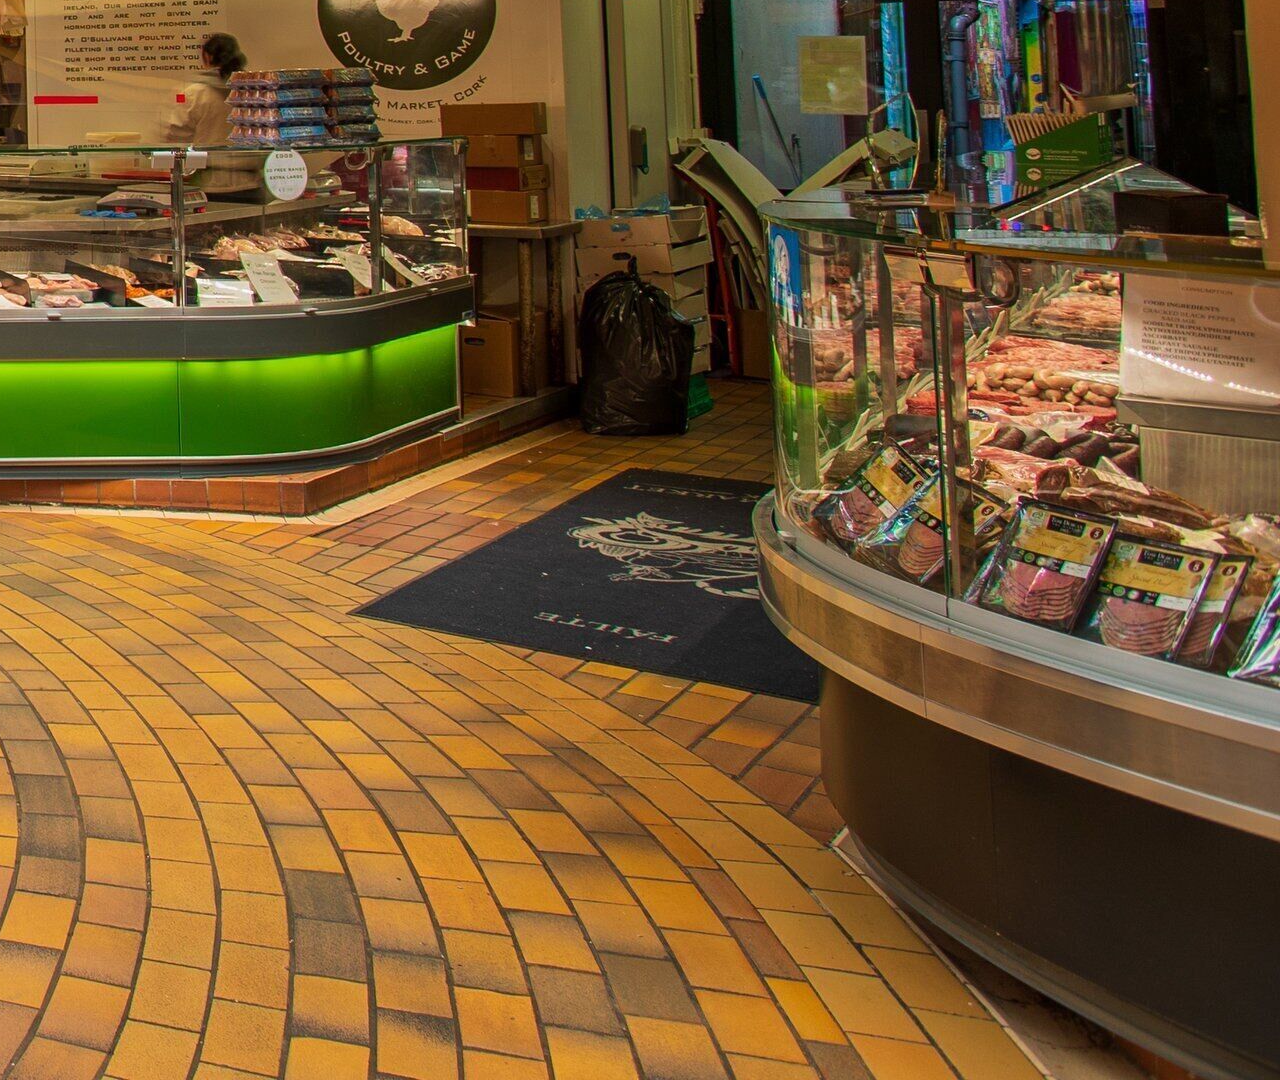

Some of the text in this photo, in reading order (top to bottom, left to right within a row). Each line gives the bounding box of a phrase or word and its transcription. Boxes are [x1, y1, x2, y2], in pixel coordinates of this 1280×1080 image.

[337, 28, 476, 76] POULTRY & GAME
[453, 74, 488, 103] CORK
[1167, 301, 1220, 312] INGREDIENTS
[1142, 320, 1173, 328] SODIUM
